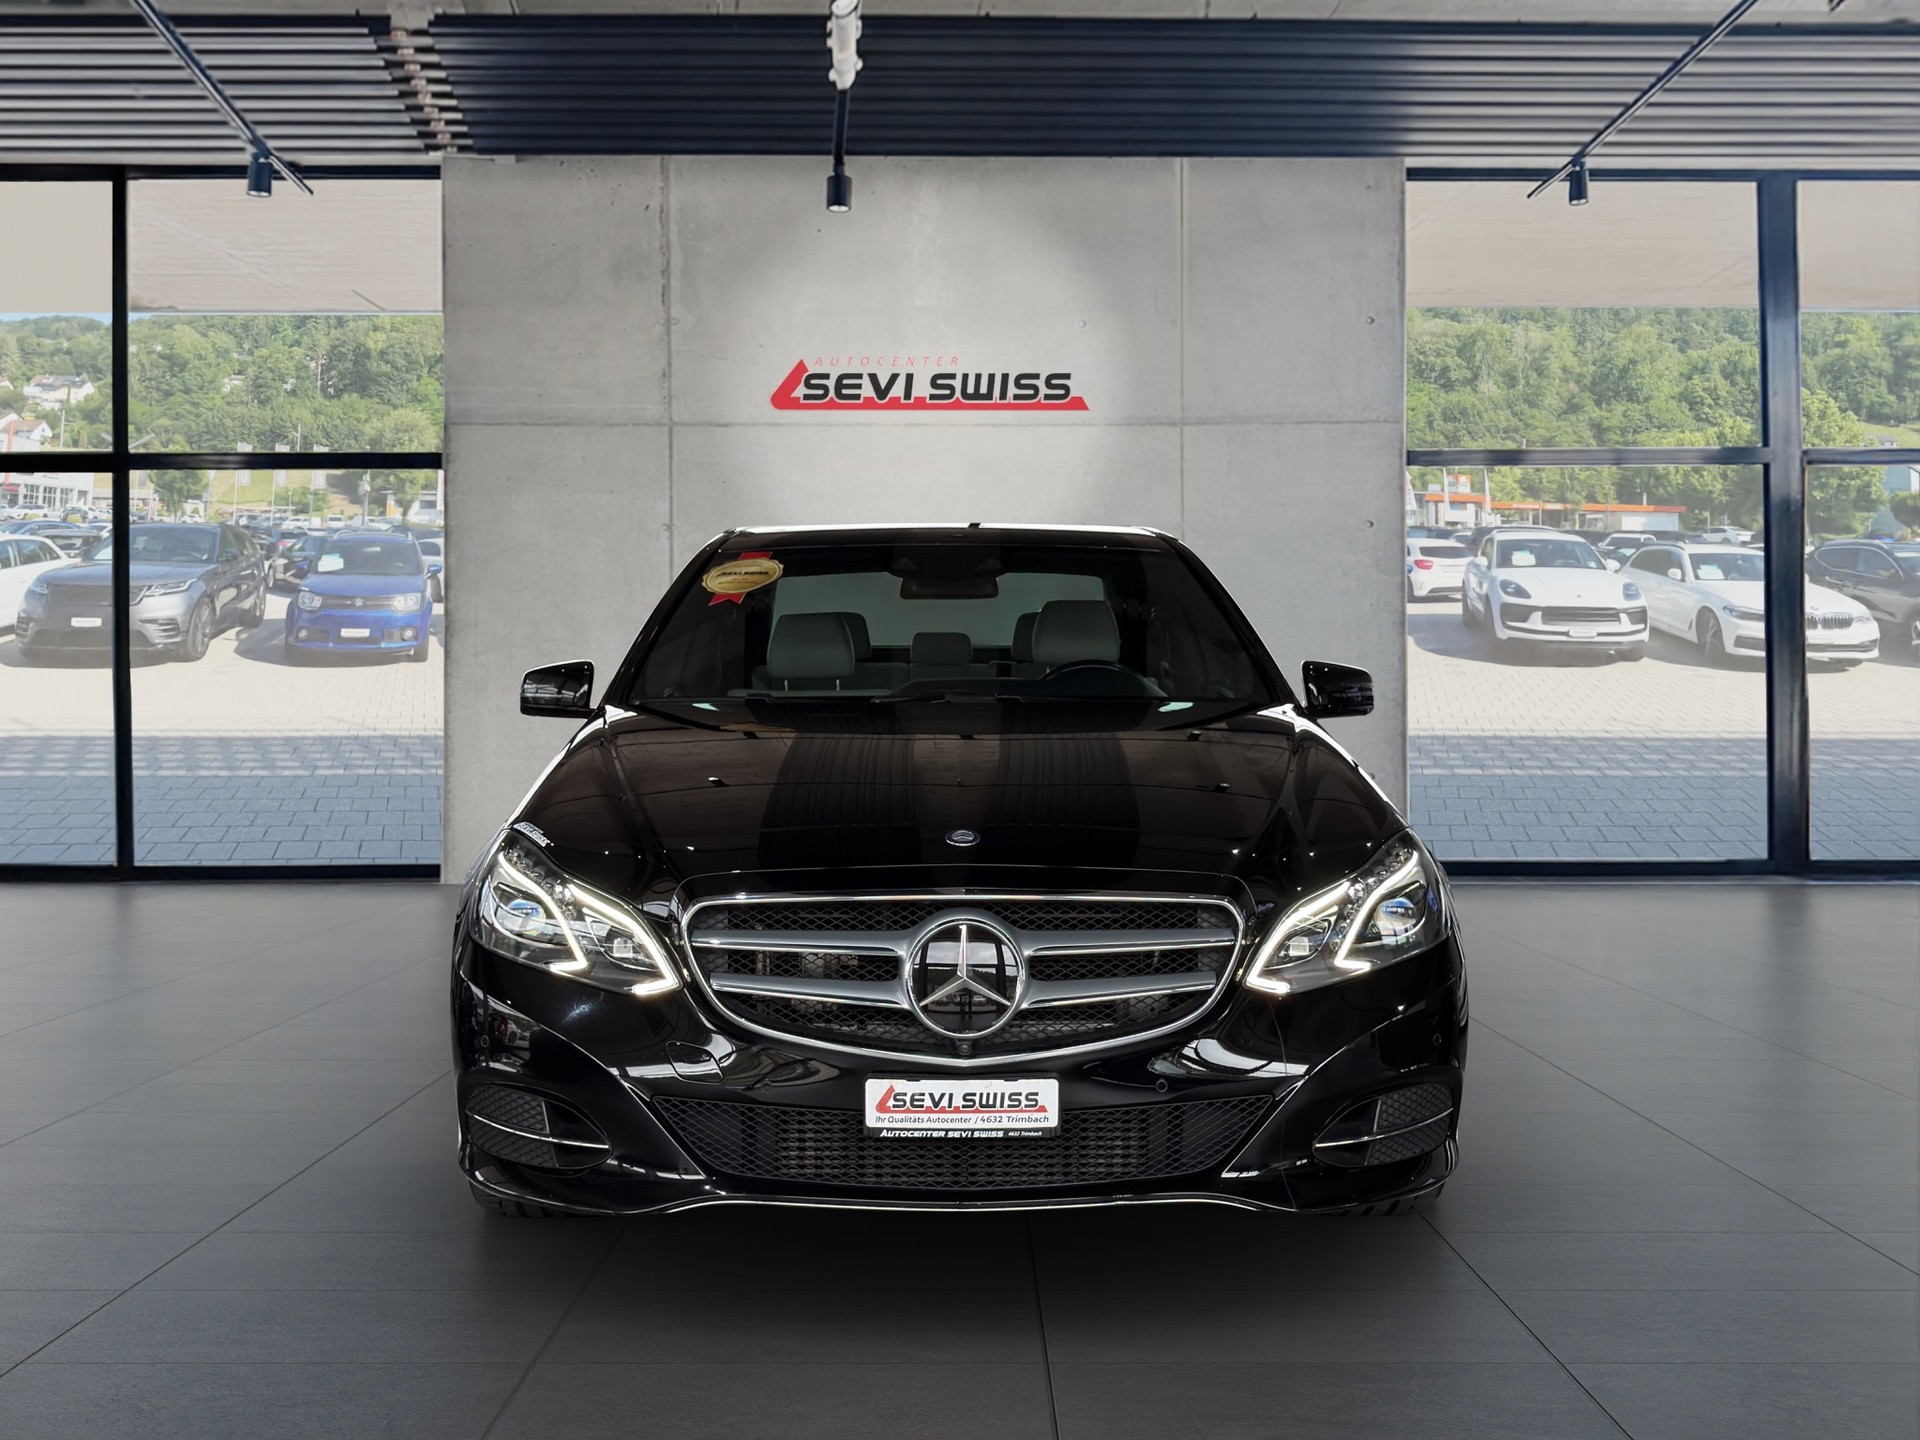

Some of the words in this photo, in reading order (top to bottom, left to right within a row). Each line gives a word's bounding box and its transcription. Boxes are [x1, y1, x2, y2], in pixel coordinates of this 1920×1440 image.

[814, 356, 959, 366] AUTOCENTER
[802, 372, 914, 401] SEVI
[928, 372, 1072, 401] SWISS
[892, 1092, 953, 1109] SEVI
[961, 1092, 1040, 1108] SWISS
[927, 1116, 972, 1124] Autocenter
[1006, 1115, 1049, 1123] Trimbach
[972, 1130, 1004, 1138] SWISS
